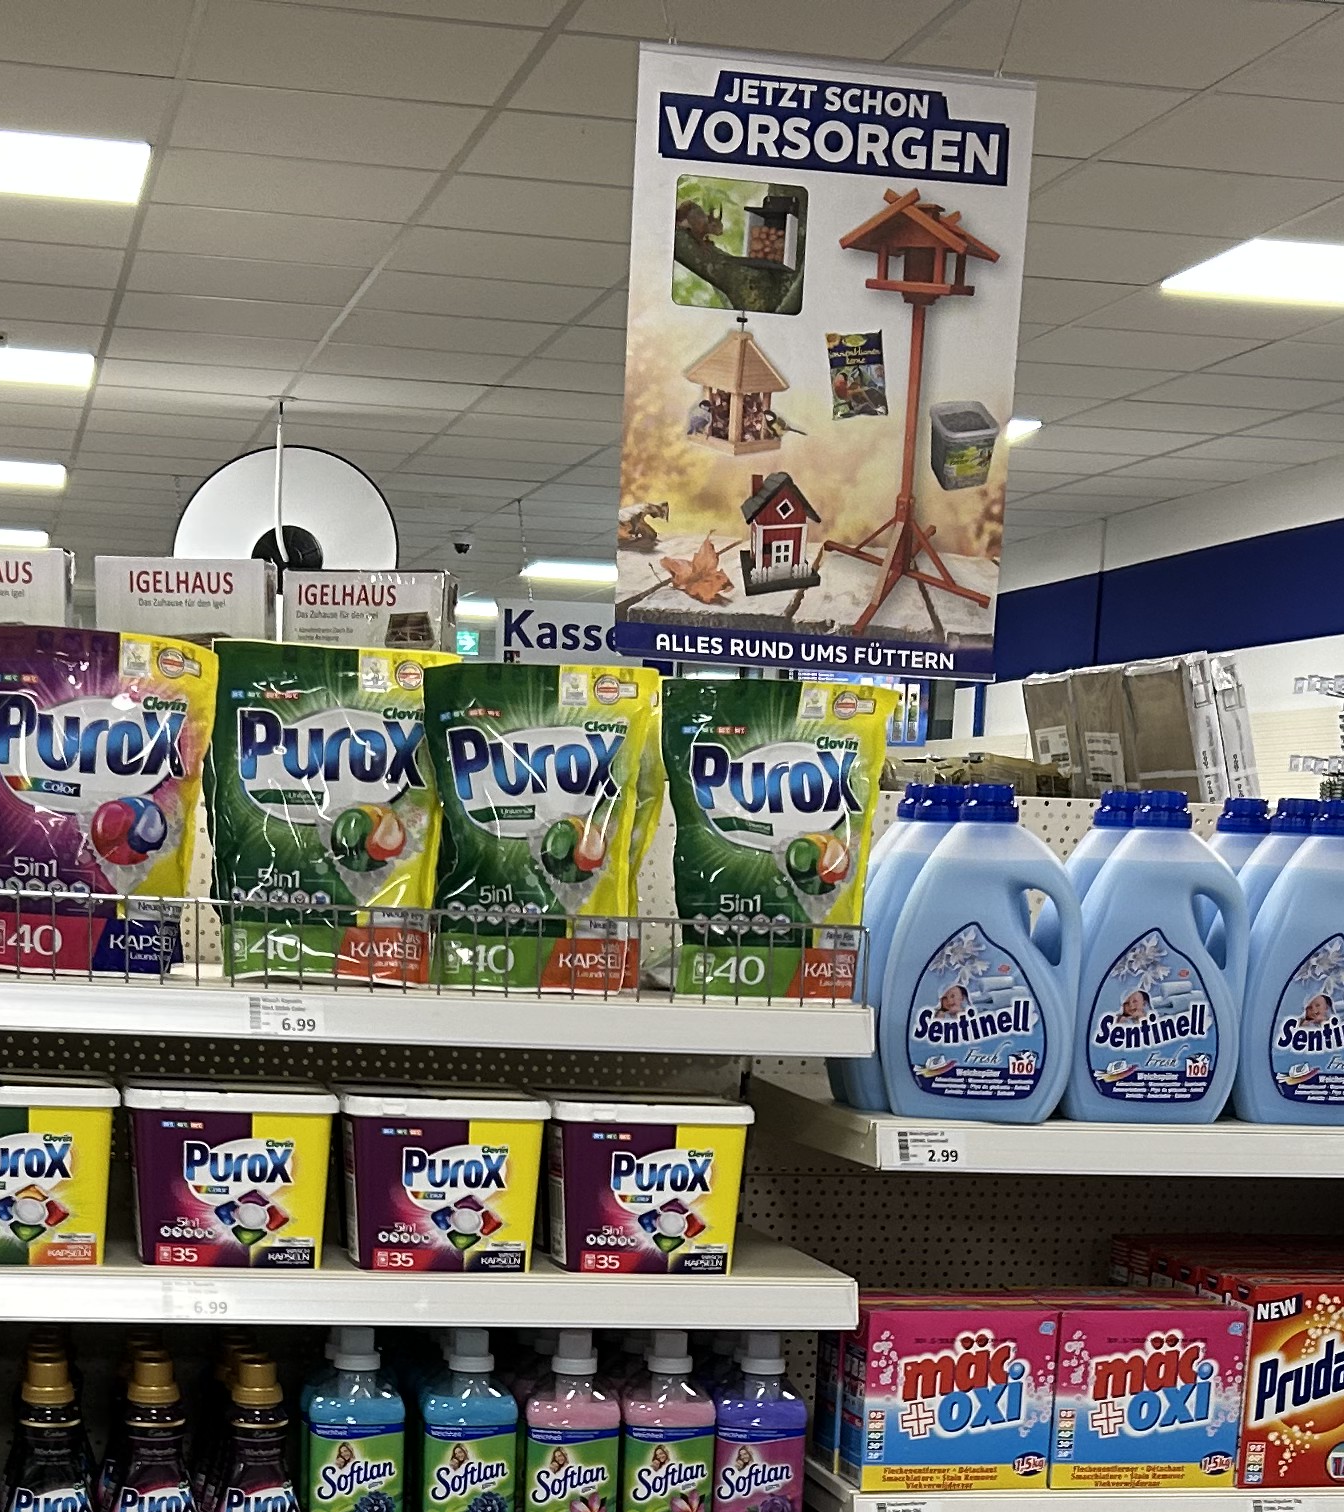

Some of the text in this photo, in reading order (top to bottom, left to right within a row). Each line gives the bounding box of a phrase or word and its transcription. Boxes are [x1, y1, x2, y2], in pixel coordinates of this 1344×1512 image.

[724, 77, 930, 119] JETZT SCHON
[664, 106, 1001, 175] VORSORGEN
[129, 570, 234, 595] IGELHAUS
[297, 584, 397, 606] IGELHAUS
[655, 632, 955, 670] ALLES RUND UMS FÜTTERN
[816, 737, 858, 750] Clovin
[41, 781, 78, 795] Color
[690, 743, 862, 813] PuroX
[13, 858, 58, 877] 5in1
[713, 956, 764, 985] 40
[914, 1001, 1030, 1045] Sentinell
[1095, 1005, 1206, 1048] Sentinell
[963, 1042, 1001, 1067] Fresh
[1011, 1059, 1034, 1074] 100
[183, 1140, 292, 1185] PuroX
[928, 1149, 959, 1163] 2.99
[596, 1255, 620, 1269] 35
[1257, 1297, 1296, 1319] NEW
[902, 1335, 1011, 1400] mäc
[1092, 1334, 1199, 1400] mäc
[317, 1459, 395, 1500] Softlan
[532, 1464, 608, 1503] Softlan
[717, 1460, 792, 1500] Softlan
